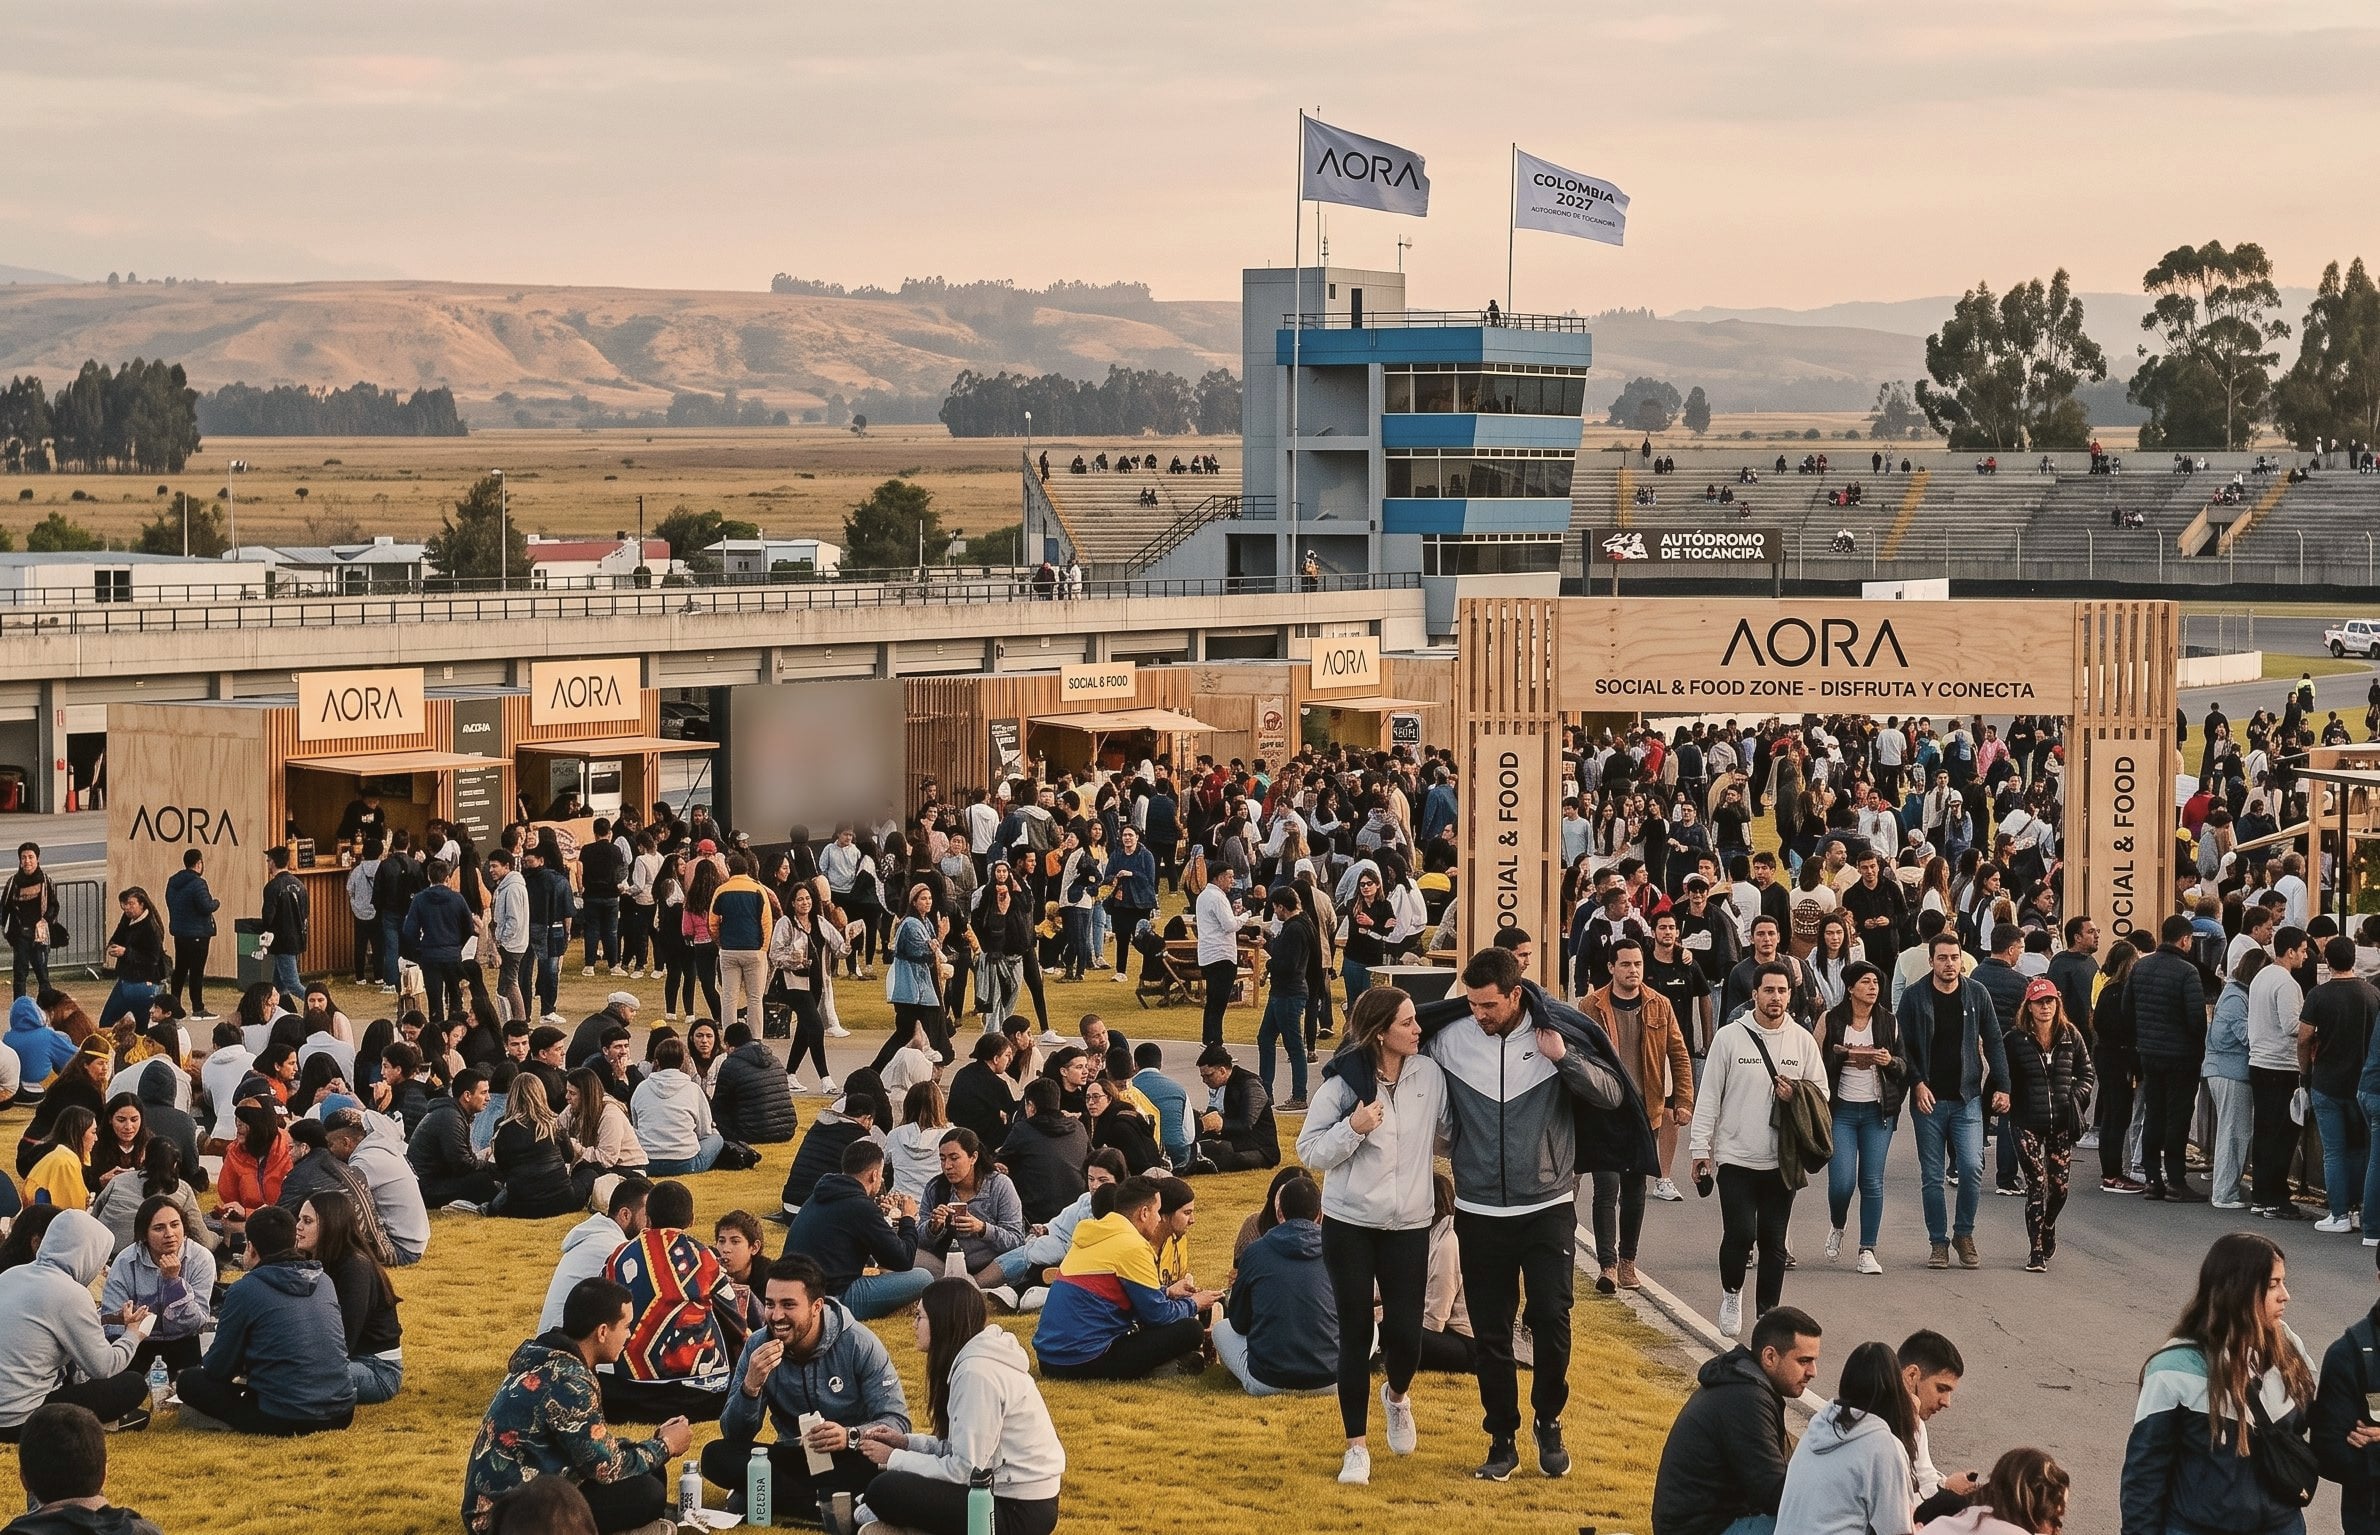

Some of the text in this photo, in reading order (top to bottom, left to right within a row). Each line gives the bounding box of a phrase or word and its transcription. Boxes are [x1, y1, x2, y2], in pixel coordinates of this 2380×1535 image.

[1316, 147, 1420, 190] AORA
[1533, 173, 1615, 204] COLOMBIA
[1556, 192, 1594, 211] 2027
[1660, 530, 1765, 546] AUTÓDROMO
[1661, 547, 1681, 559] DE
[1720, 617, 1909, 667] AORA
[1322, 649, 1368, 676] AORA
[551, 674, 622, 709] AORA
[1069, 676, 1098, 690] SOCIAL
[1106, 674, 1128, 688] FOOD
[1595, 679, 1667, 695] SOCIAL
[1671, 680, 1685, 695] &
[1690, 680, 1745, 695] FOOD
[1749, 680, 1804, 696] ZONE
[1821, 681, 1917, 697] DISFRUTA
[1921, 681, 1934, 697] Y
[1938, 682, 2036, 698] CONECTA
[321, 686, 403, 722] AORA
[129, 804, 239, 847] AORA
[1497, 752, 1519, 929] OCIAL & FOOD
[2112, 756, 2135, 943] OCIAL & FOOD
